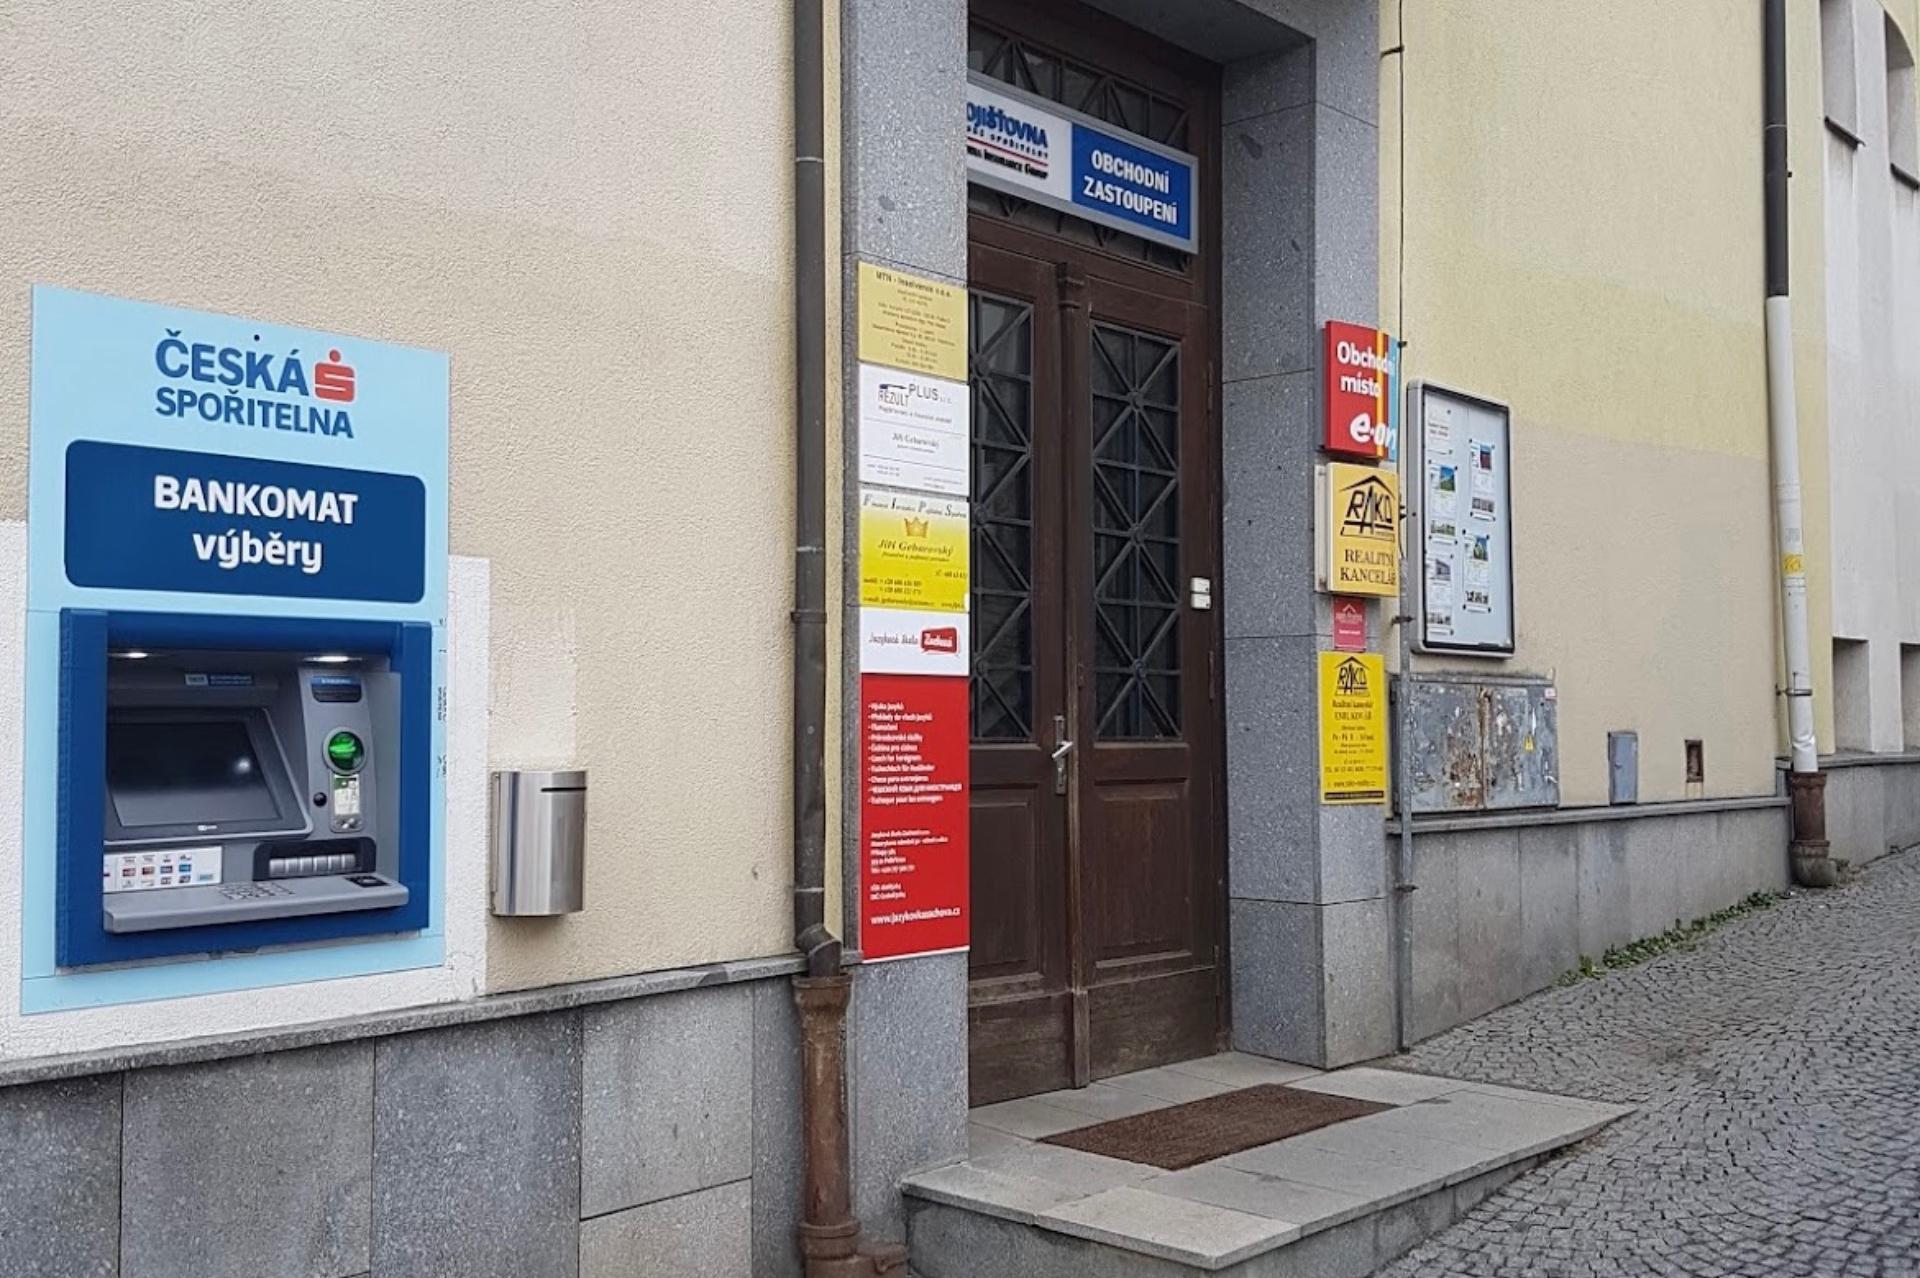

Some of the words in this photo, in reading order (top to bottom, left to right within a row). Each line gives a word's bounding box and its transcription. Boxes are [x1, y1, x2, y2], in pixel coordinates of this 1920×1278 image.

[1091, 150, 1170, 195] OBCHODNÍ
[1083, 176, 1178, 225] ZASTOUPENÍ
[155, 328, 309, 396] ČESKÁ
[155, 386, 354, 439] SPOŘITELNA
[909, 384, 939, 401] PLUS
[153, 474, 358, 525] BANKOMAT
[193, 530, 324, 575] výběry
